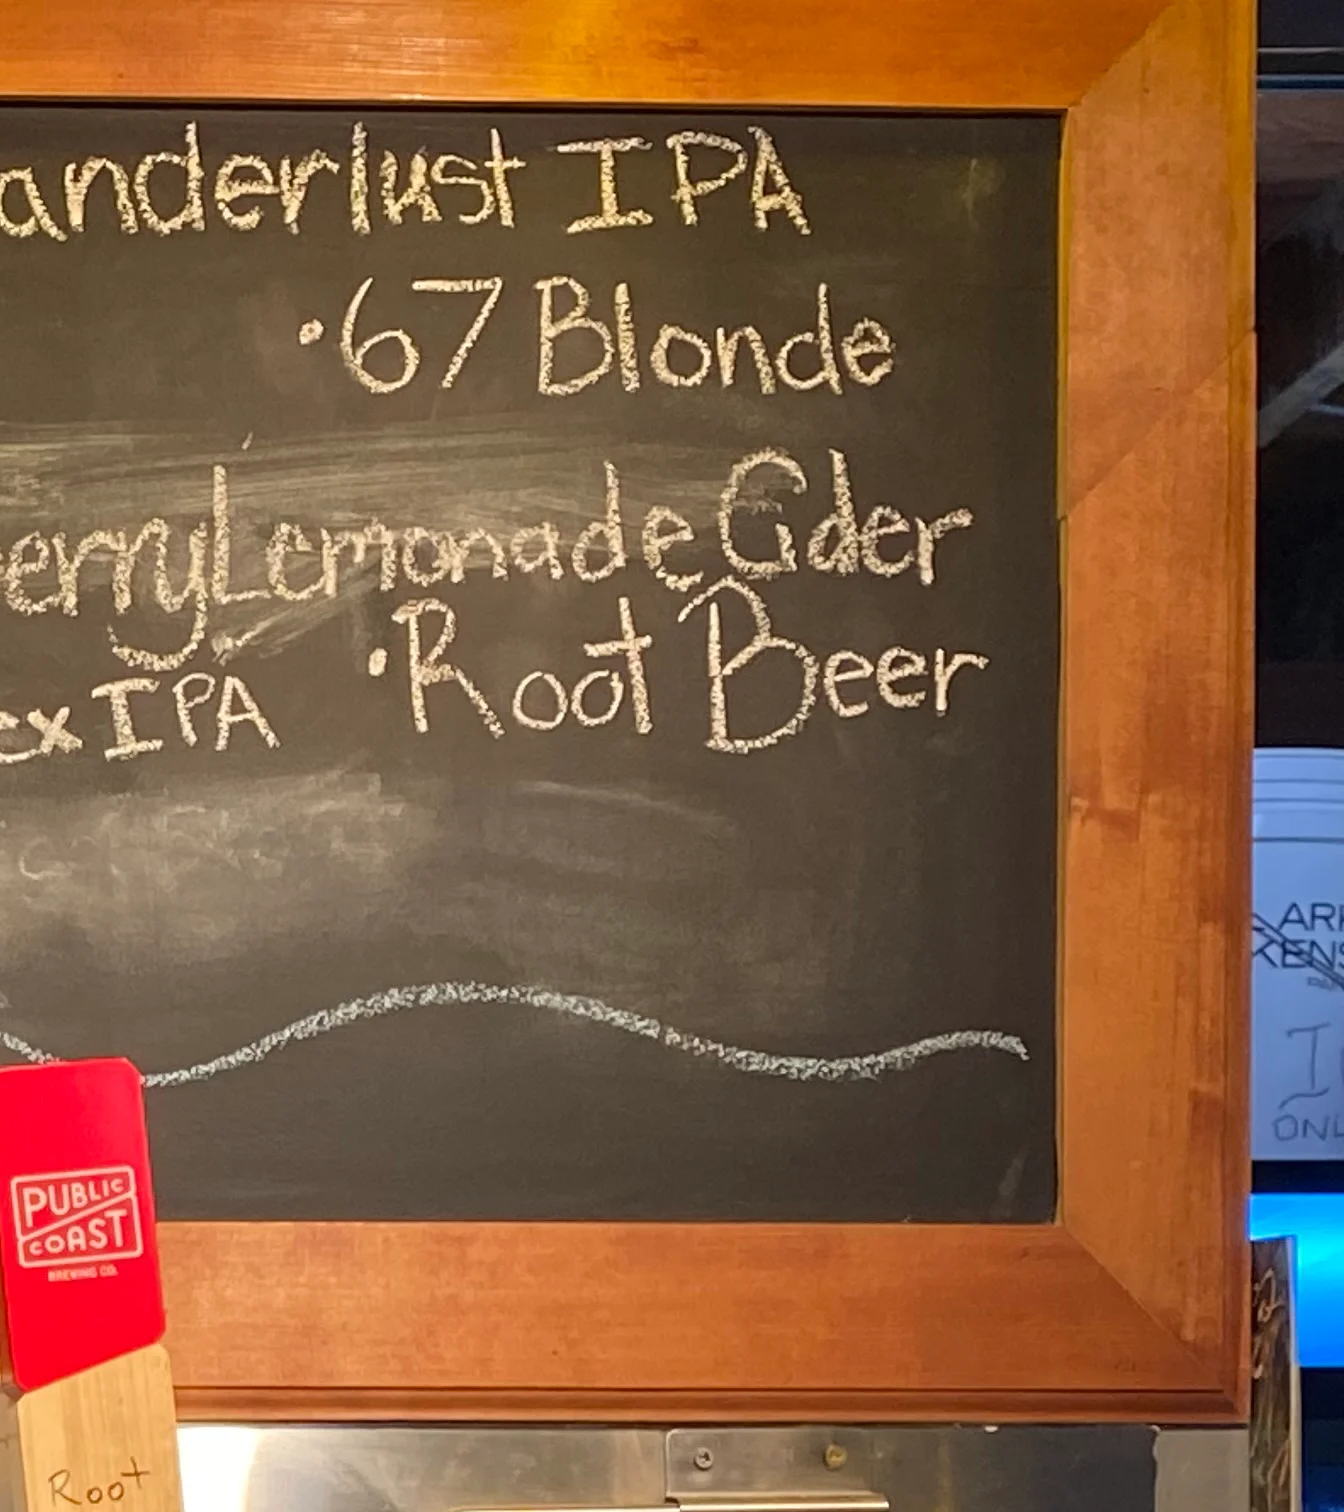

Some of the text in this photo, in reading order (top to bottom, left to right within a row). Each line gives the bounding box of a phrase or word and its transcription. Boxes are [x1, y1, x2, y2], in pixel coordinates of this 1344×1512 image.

[562, 128, 815, 239] IPA
[338, 276, 897, 397] 67 Blonde
[392, 579, 990, 759] Root Beer
[100, 670, 282, 763] IPA
[23, 1174, 125, 1230] PUBLIC
[28, 1207, 130, 1258] COAST
[48, 1456, 151, 1508] Root
